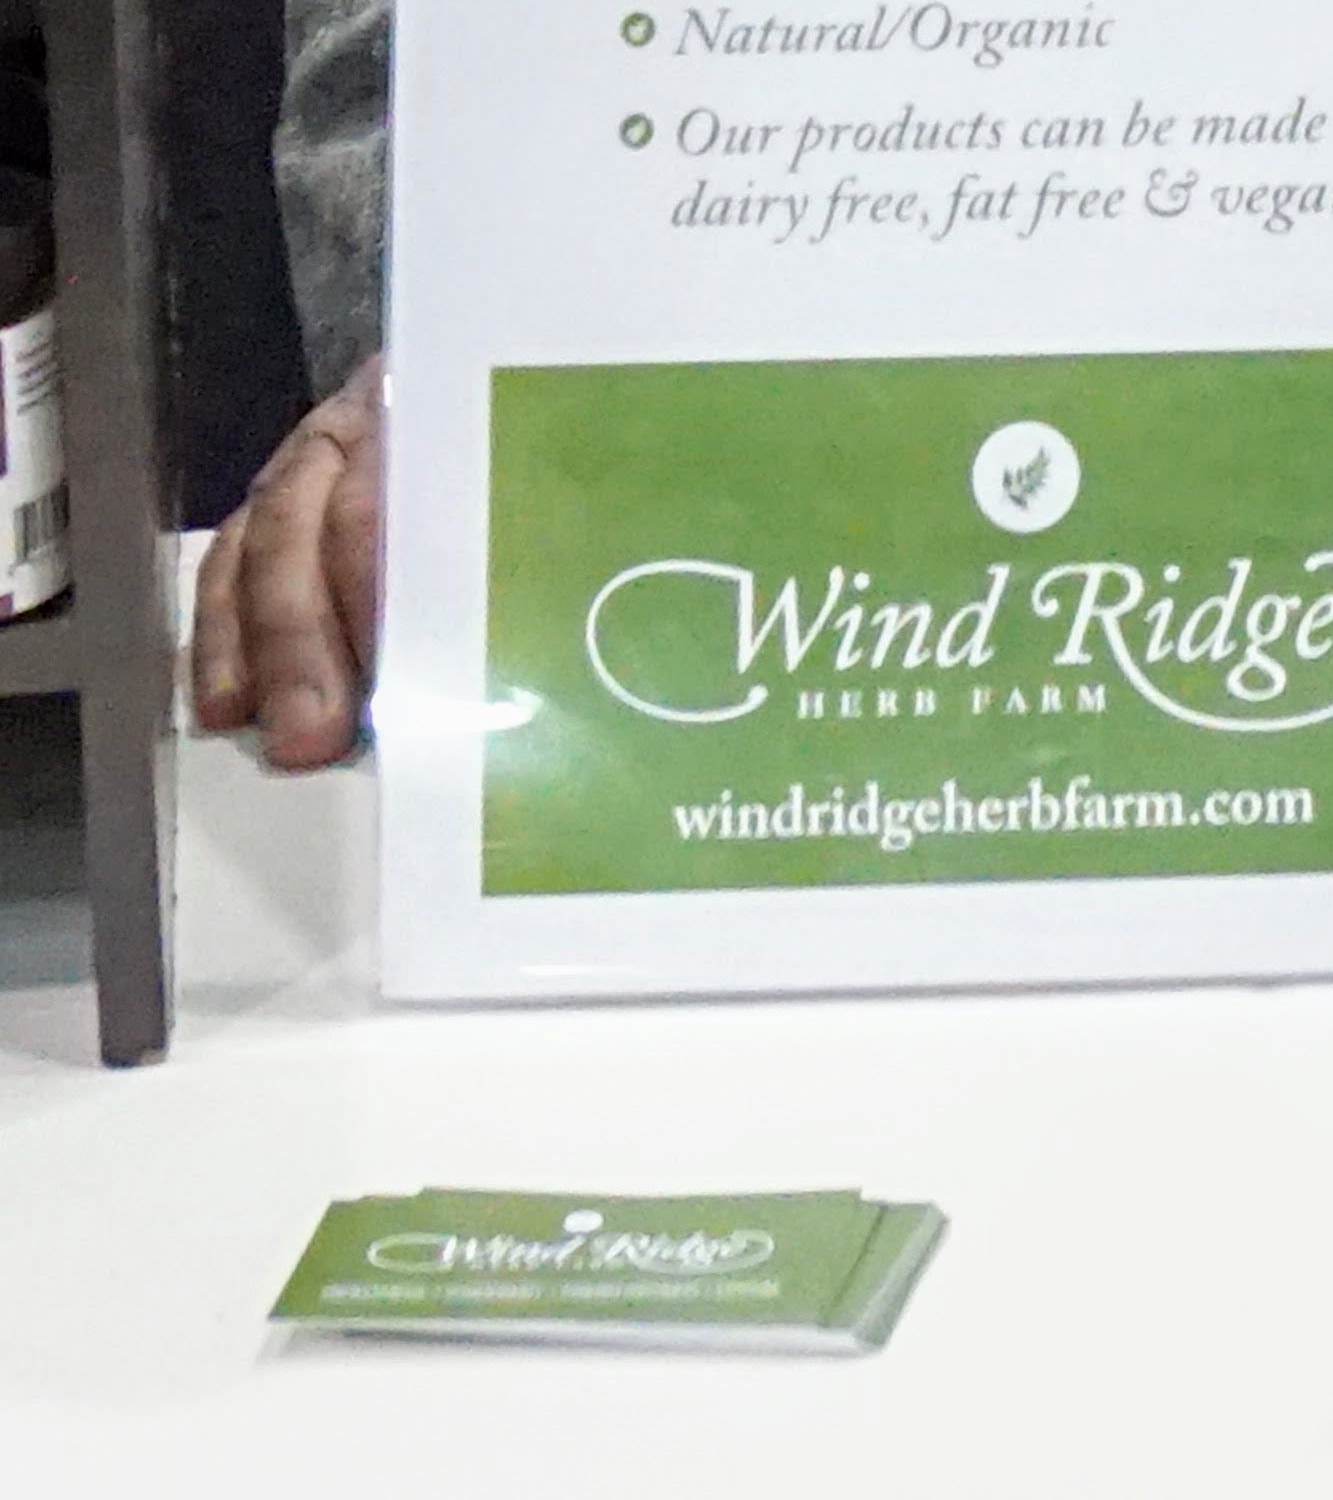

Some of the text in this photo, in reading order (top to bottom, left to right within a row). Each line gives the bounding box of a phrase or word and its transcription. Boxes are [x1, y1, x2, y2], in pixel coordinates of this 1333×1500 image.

[673, 1, 1117, 68] Natural/Organic
[674, 97, 1326, 174] Our products can be made
[671, 178, 809, 244] dairy
[813, 173, 930, 244] free,
[931, 173, 1016, 243] fat
[1017, 170, 1125, 240] free
[1144, 168, 1198, 218] &
[586, 559, 1009, 723] Wind
[796, 683, 1109, 720] HERB FARM
[673, 777, 1314, 852] windridgeherbfarm.com
